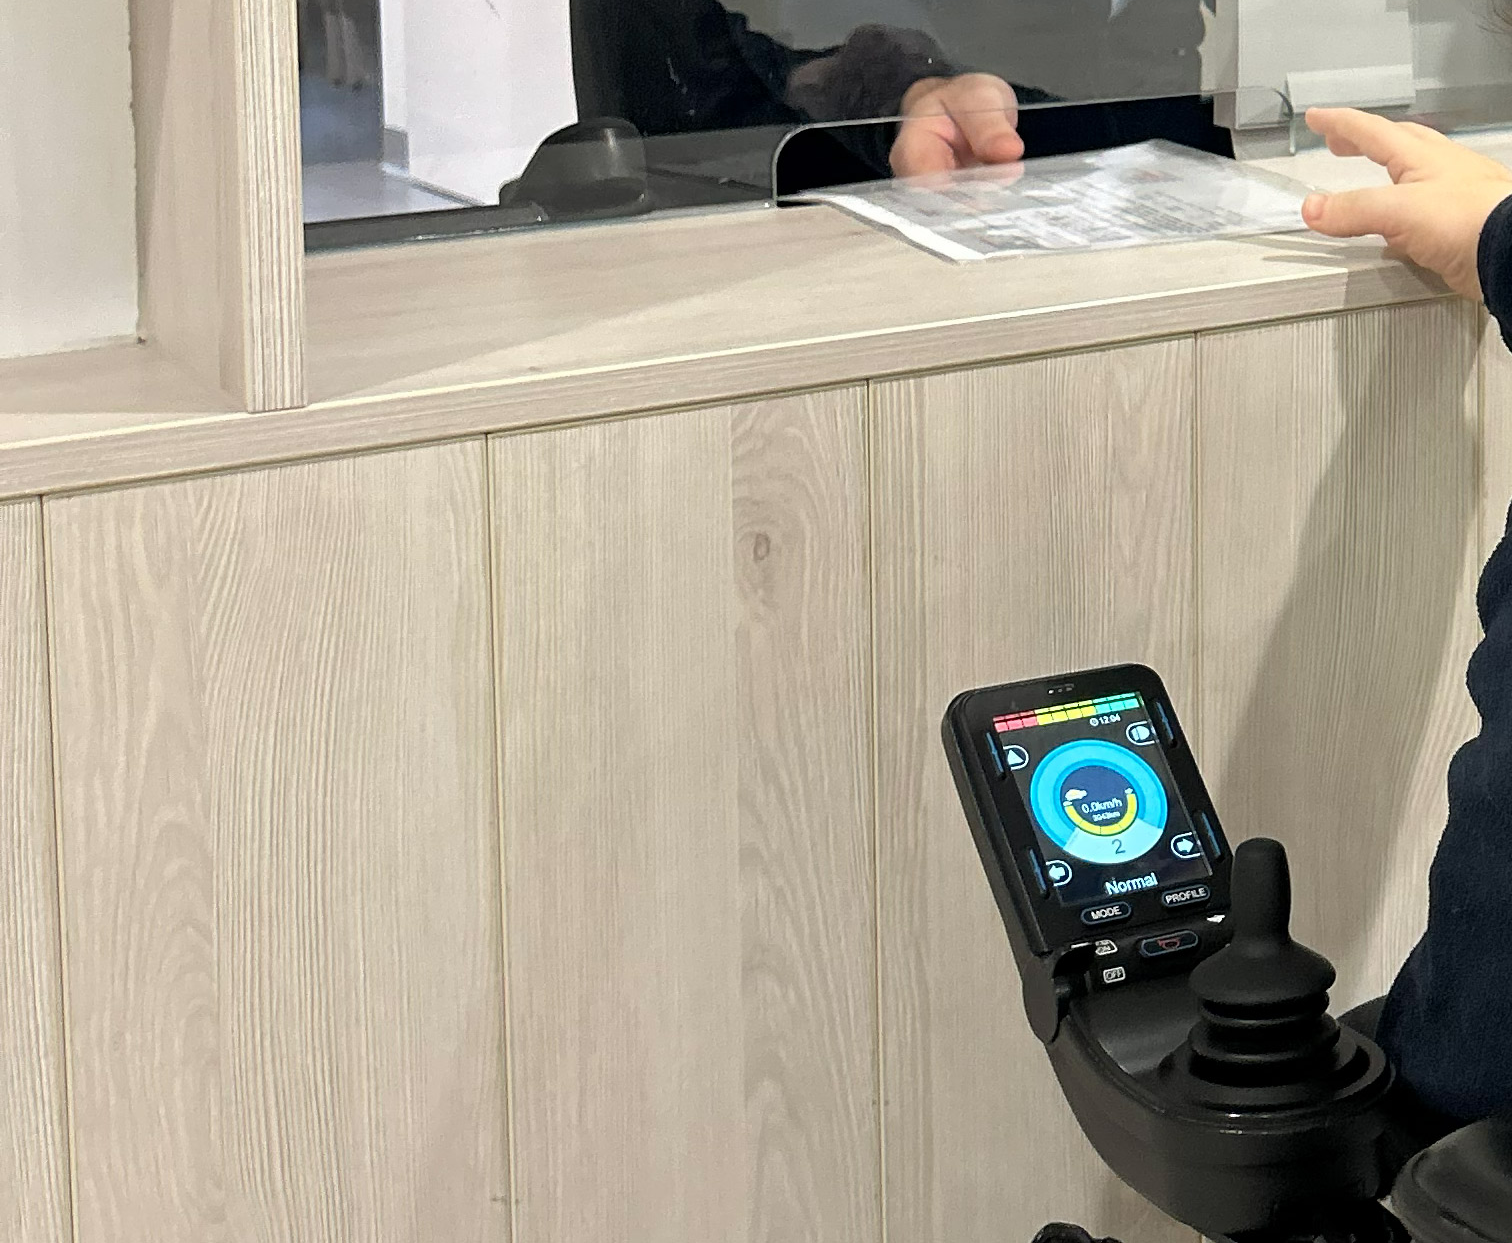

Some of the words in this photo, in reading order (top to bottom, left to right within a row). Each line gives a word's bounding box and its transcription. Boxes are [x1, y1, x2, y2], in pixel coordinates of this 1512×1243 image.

[1112, 839, 1126, 855] 2
[1105, 872, 1158, 896] Normal
[1091, 905, 1121, 920] MODE
[1165, 887, 1206, 906] PROFILE
